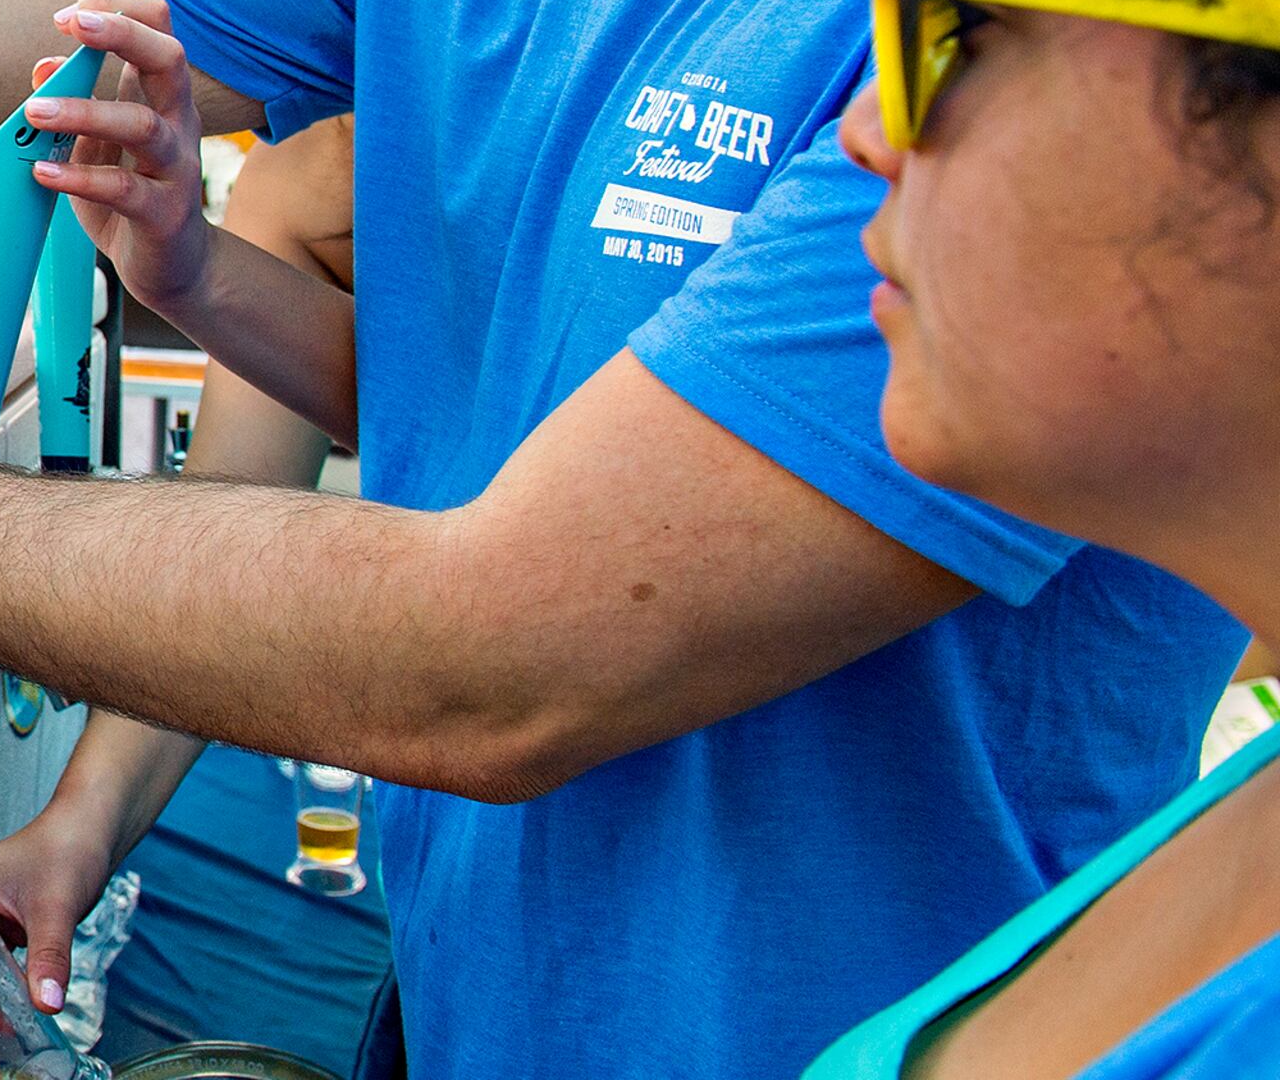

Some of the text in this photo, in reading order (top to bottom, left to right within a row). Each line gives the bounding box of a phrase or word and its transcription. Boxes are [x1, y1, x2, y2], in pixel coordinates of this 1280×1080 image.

[694, 100, 774, 167] BEER
[623, 140, 724, 184] Festival
[613, 196, 704, 234] SPRING EDITION
[603, 236, 629, 257] MAY
[646, 242, 684, 267] 2015
